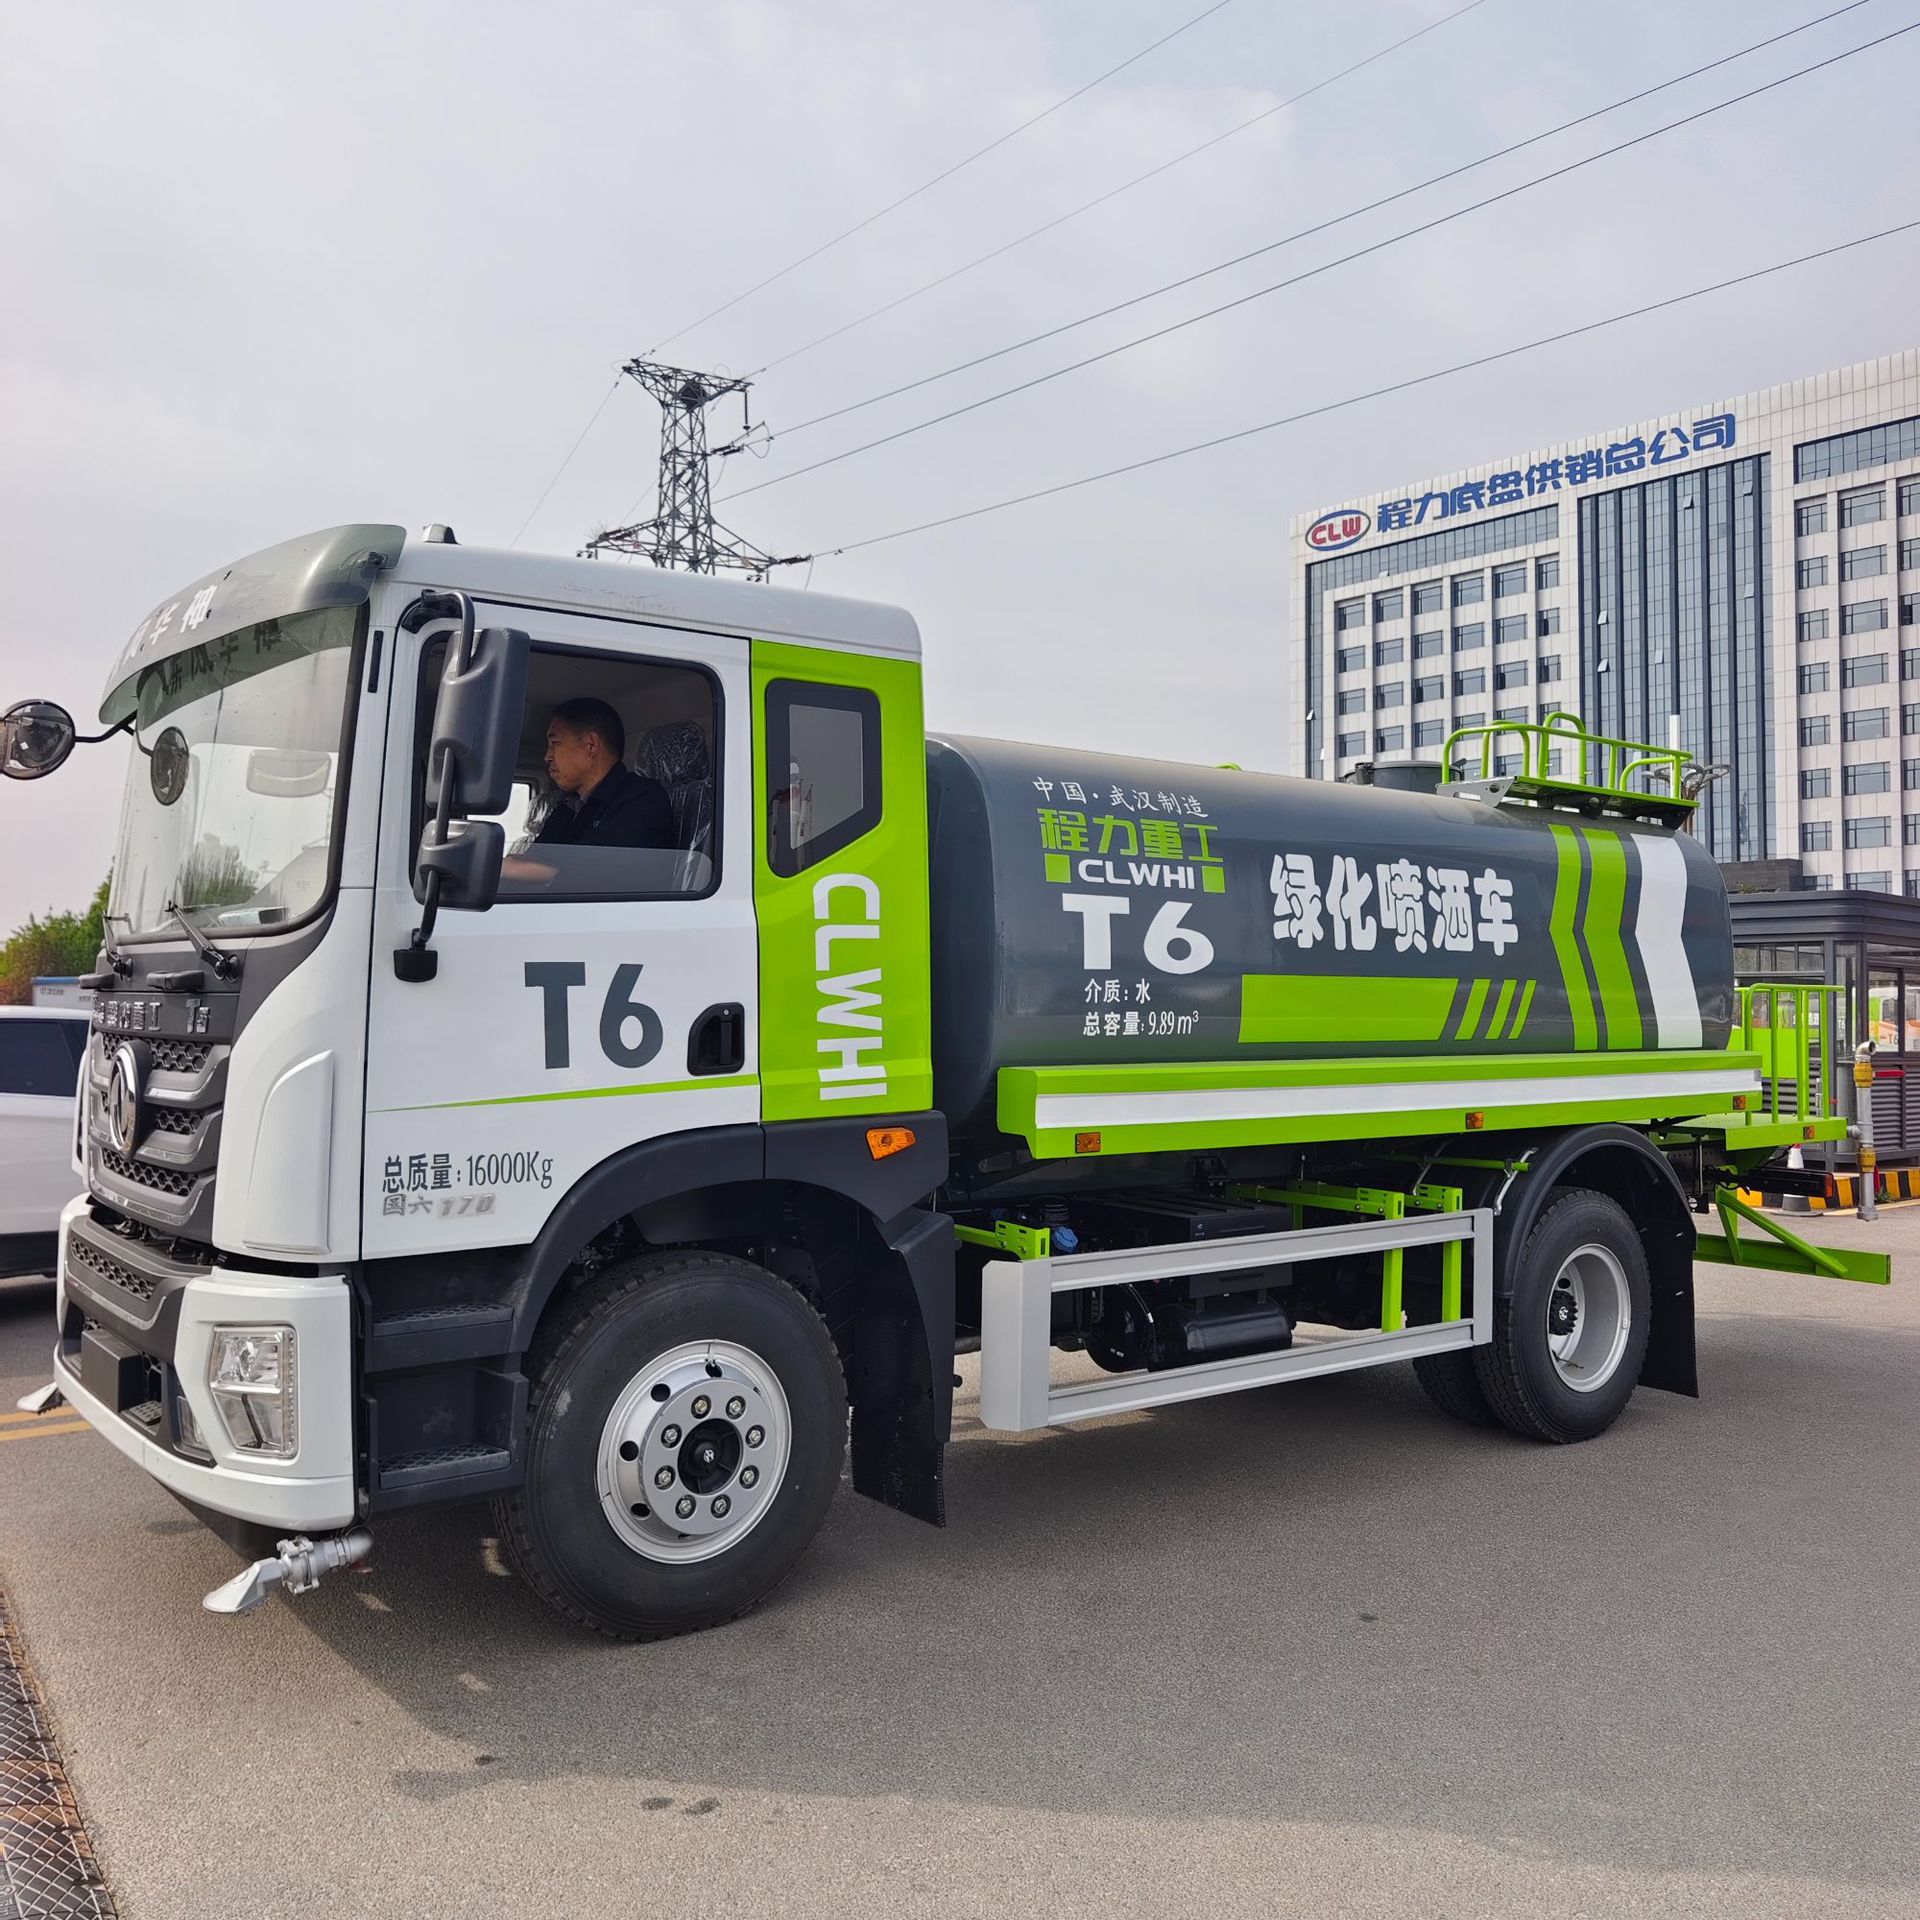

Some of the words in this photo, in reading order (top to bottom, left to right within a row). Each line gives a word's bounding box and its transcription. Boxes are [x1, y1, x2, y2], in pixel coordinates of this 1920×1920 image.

[1377, 413, 1736, 533] 程力底盘供销总公司
[1311, 514, 1361, 544] CLW
[1036, 808, 1224, 863] 程力重工
[1077, 858, 1195, 890] CLWHI
[1062, 892, 1215, 975] T6
[1269, 853, 1519, 957] 绿化喷洒车
[524, 961, 664, 1070] T6
[812, 873, 888, 1100] CLWHI
